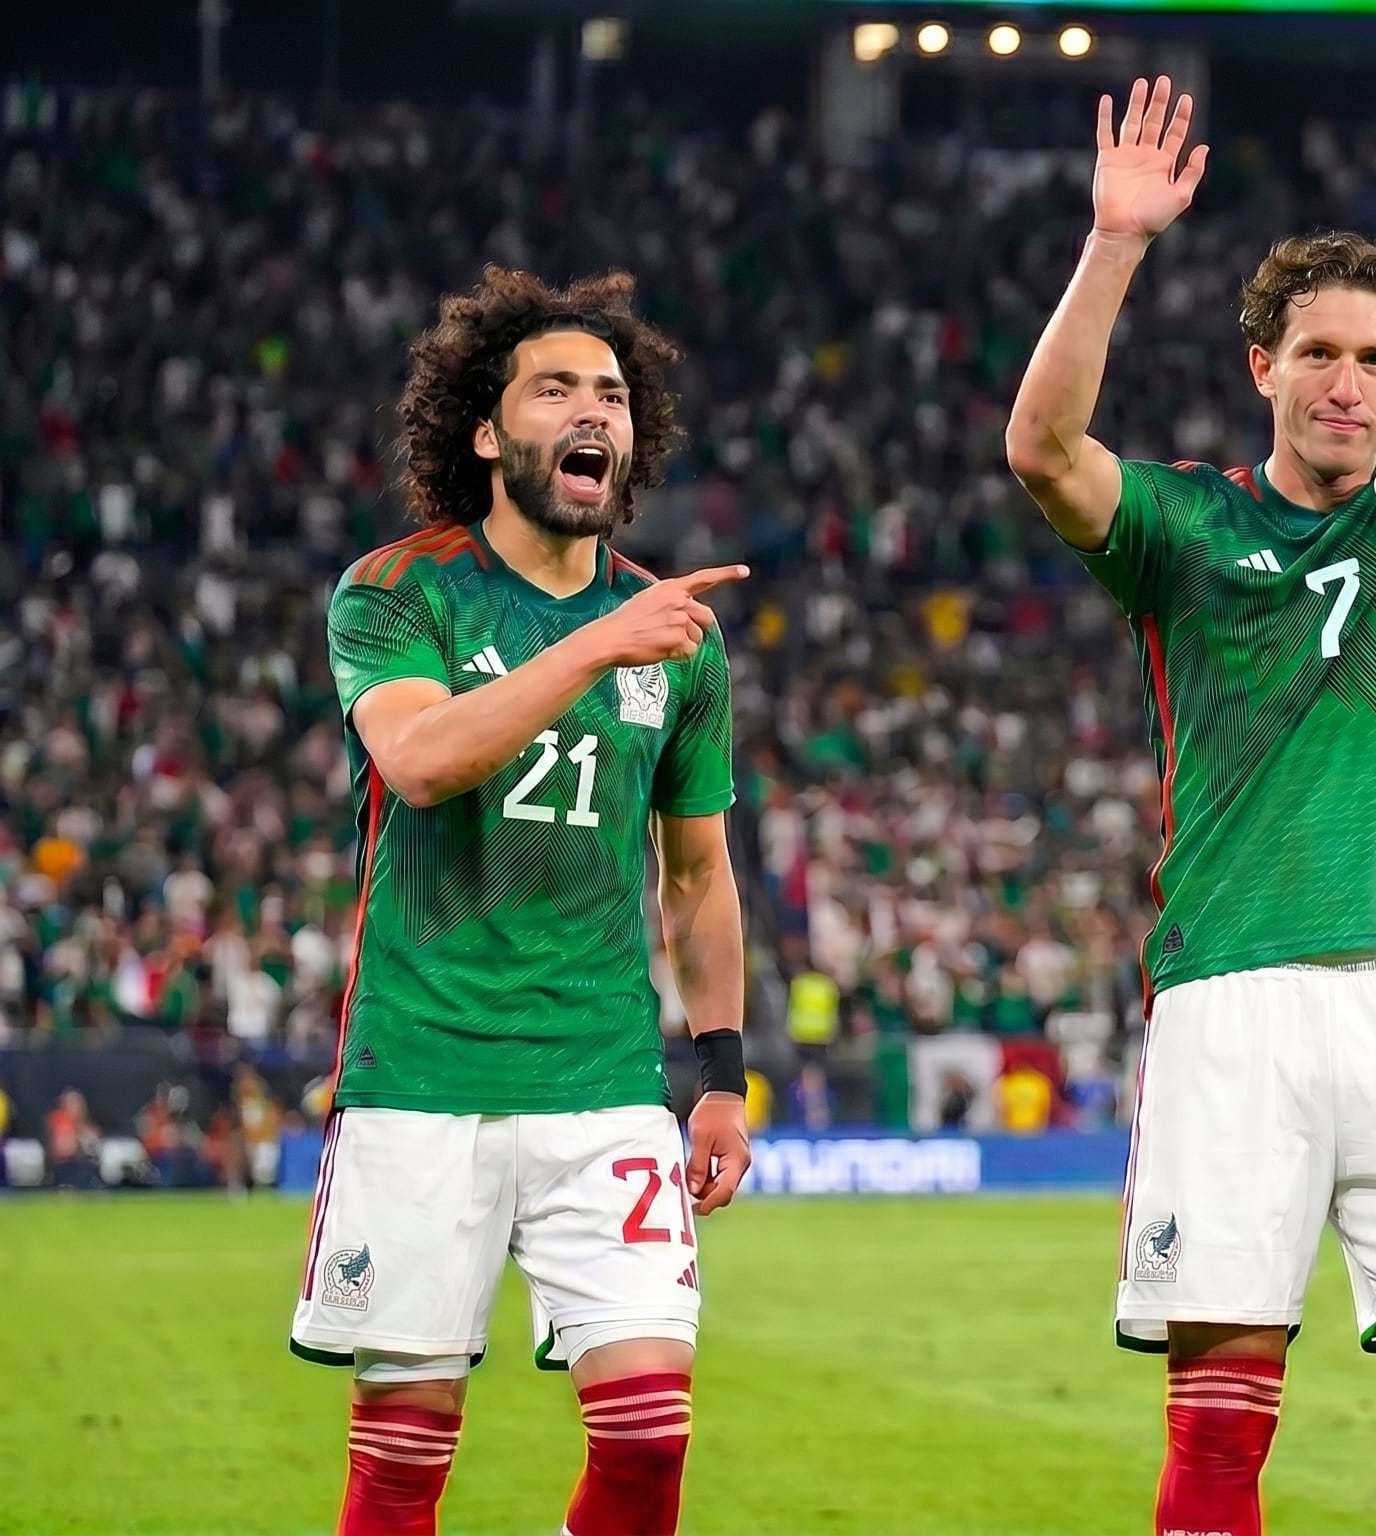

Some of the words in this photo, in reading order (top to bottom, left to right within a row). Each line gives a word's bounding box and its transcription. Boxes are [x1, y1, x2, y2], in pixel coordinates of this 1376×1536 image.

[1305, 557, 1361, 659] 7
[502, 729, 600, 828] 21
[612, 1157, 695, 1248] 21
